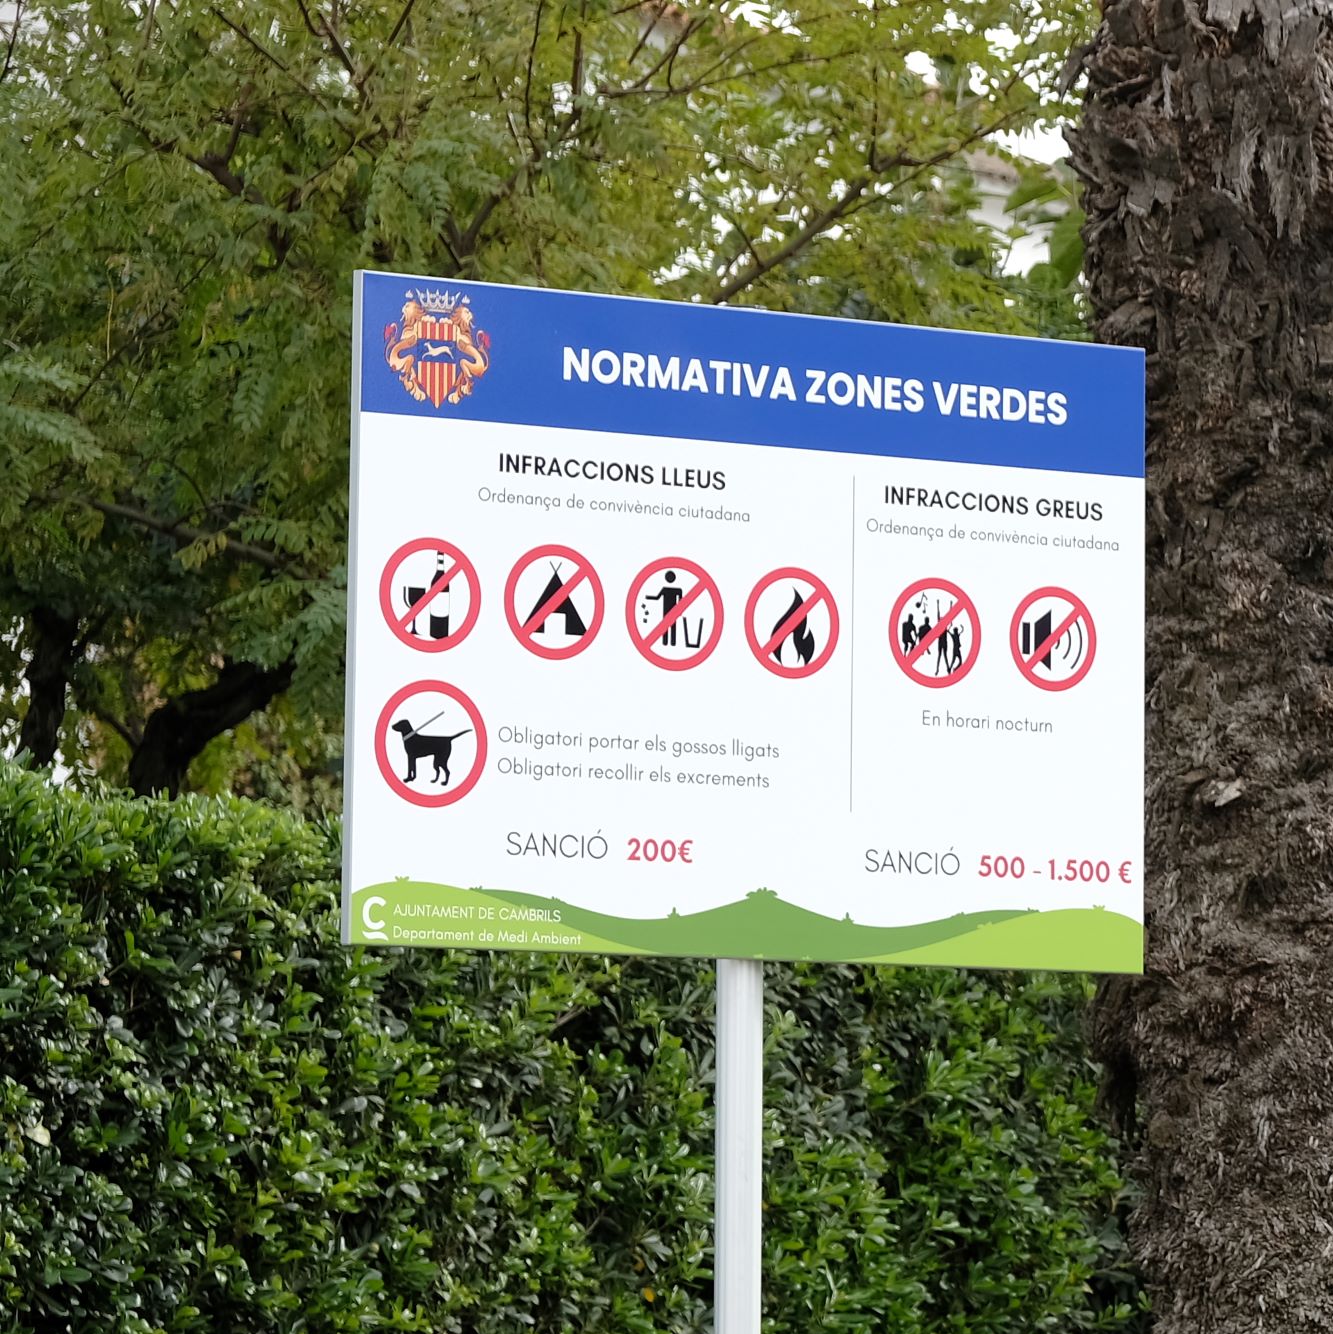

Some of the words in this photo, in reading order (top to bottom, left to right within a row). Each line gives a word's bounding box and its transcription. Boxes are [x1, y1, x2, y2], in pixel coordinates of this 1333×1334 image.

[562, 346, 797, 401] NORMATIVA
[805, 369, 925, 413] ZONES
[932, 381, 1068, 426] VERDES
[499, 453, 654, 485] INFRACCIONS
[661, 466, 727, 490] LLEUS
[478, 486, 561, 512] Ordenança
[566, 493, 585, 509] de
[589, 500, 674, 517] convivència
[678, 504, 751, 522] ciutadana
[884, 485, 1029, 515] INFRACCIONS
[1036, 498, 1103, 521] GREUS
[866, 518, 944, 542] Ordenança
[948, 523, 966, 539] de
[970, 530, 1048, 546] convivència
[1052, 534, 1120, 551] ciutadana
[922, 709, 941, 727] En
[946, 709, 990, 729] horari
[995, 717, 1053, 733] nocturn
[498, 725, 582, 750] Obligatori
[588, 733, 639, 753] portar
[644, 734, 667, 752] els
[672, 739, 727, 758] gossos
[732, 738, 780, 762] lligats
[497, 756, 582, 781] Obligatori
[588, 762, 644, 782] recollir
[649, 765, 671, 783] els
[676, 772, 770, 789] excrements
[506, 828, 608, 860] SANCIÓ
[626, 837, 694, 864] 200€
[865, 846, 961, 876] SANCIÓ
[977, 854, 1026, 880] 500
[1048, 858, 1110, 883] 1.500
[1117, 861, 1133, 884] €
[393, 904, 474, 920] AJUNTAMENT
[478, 907, 495, 920] DE
[499, 908, 562, 923] CAMBRILS
[393, 926, 474, 942] Departament
[478, 929, 495, 943] de
[498, 930, 528, 944] Medi
[531, 932, 582, 946] Ambient
